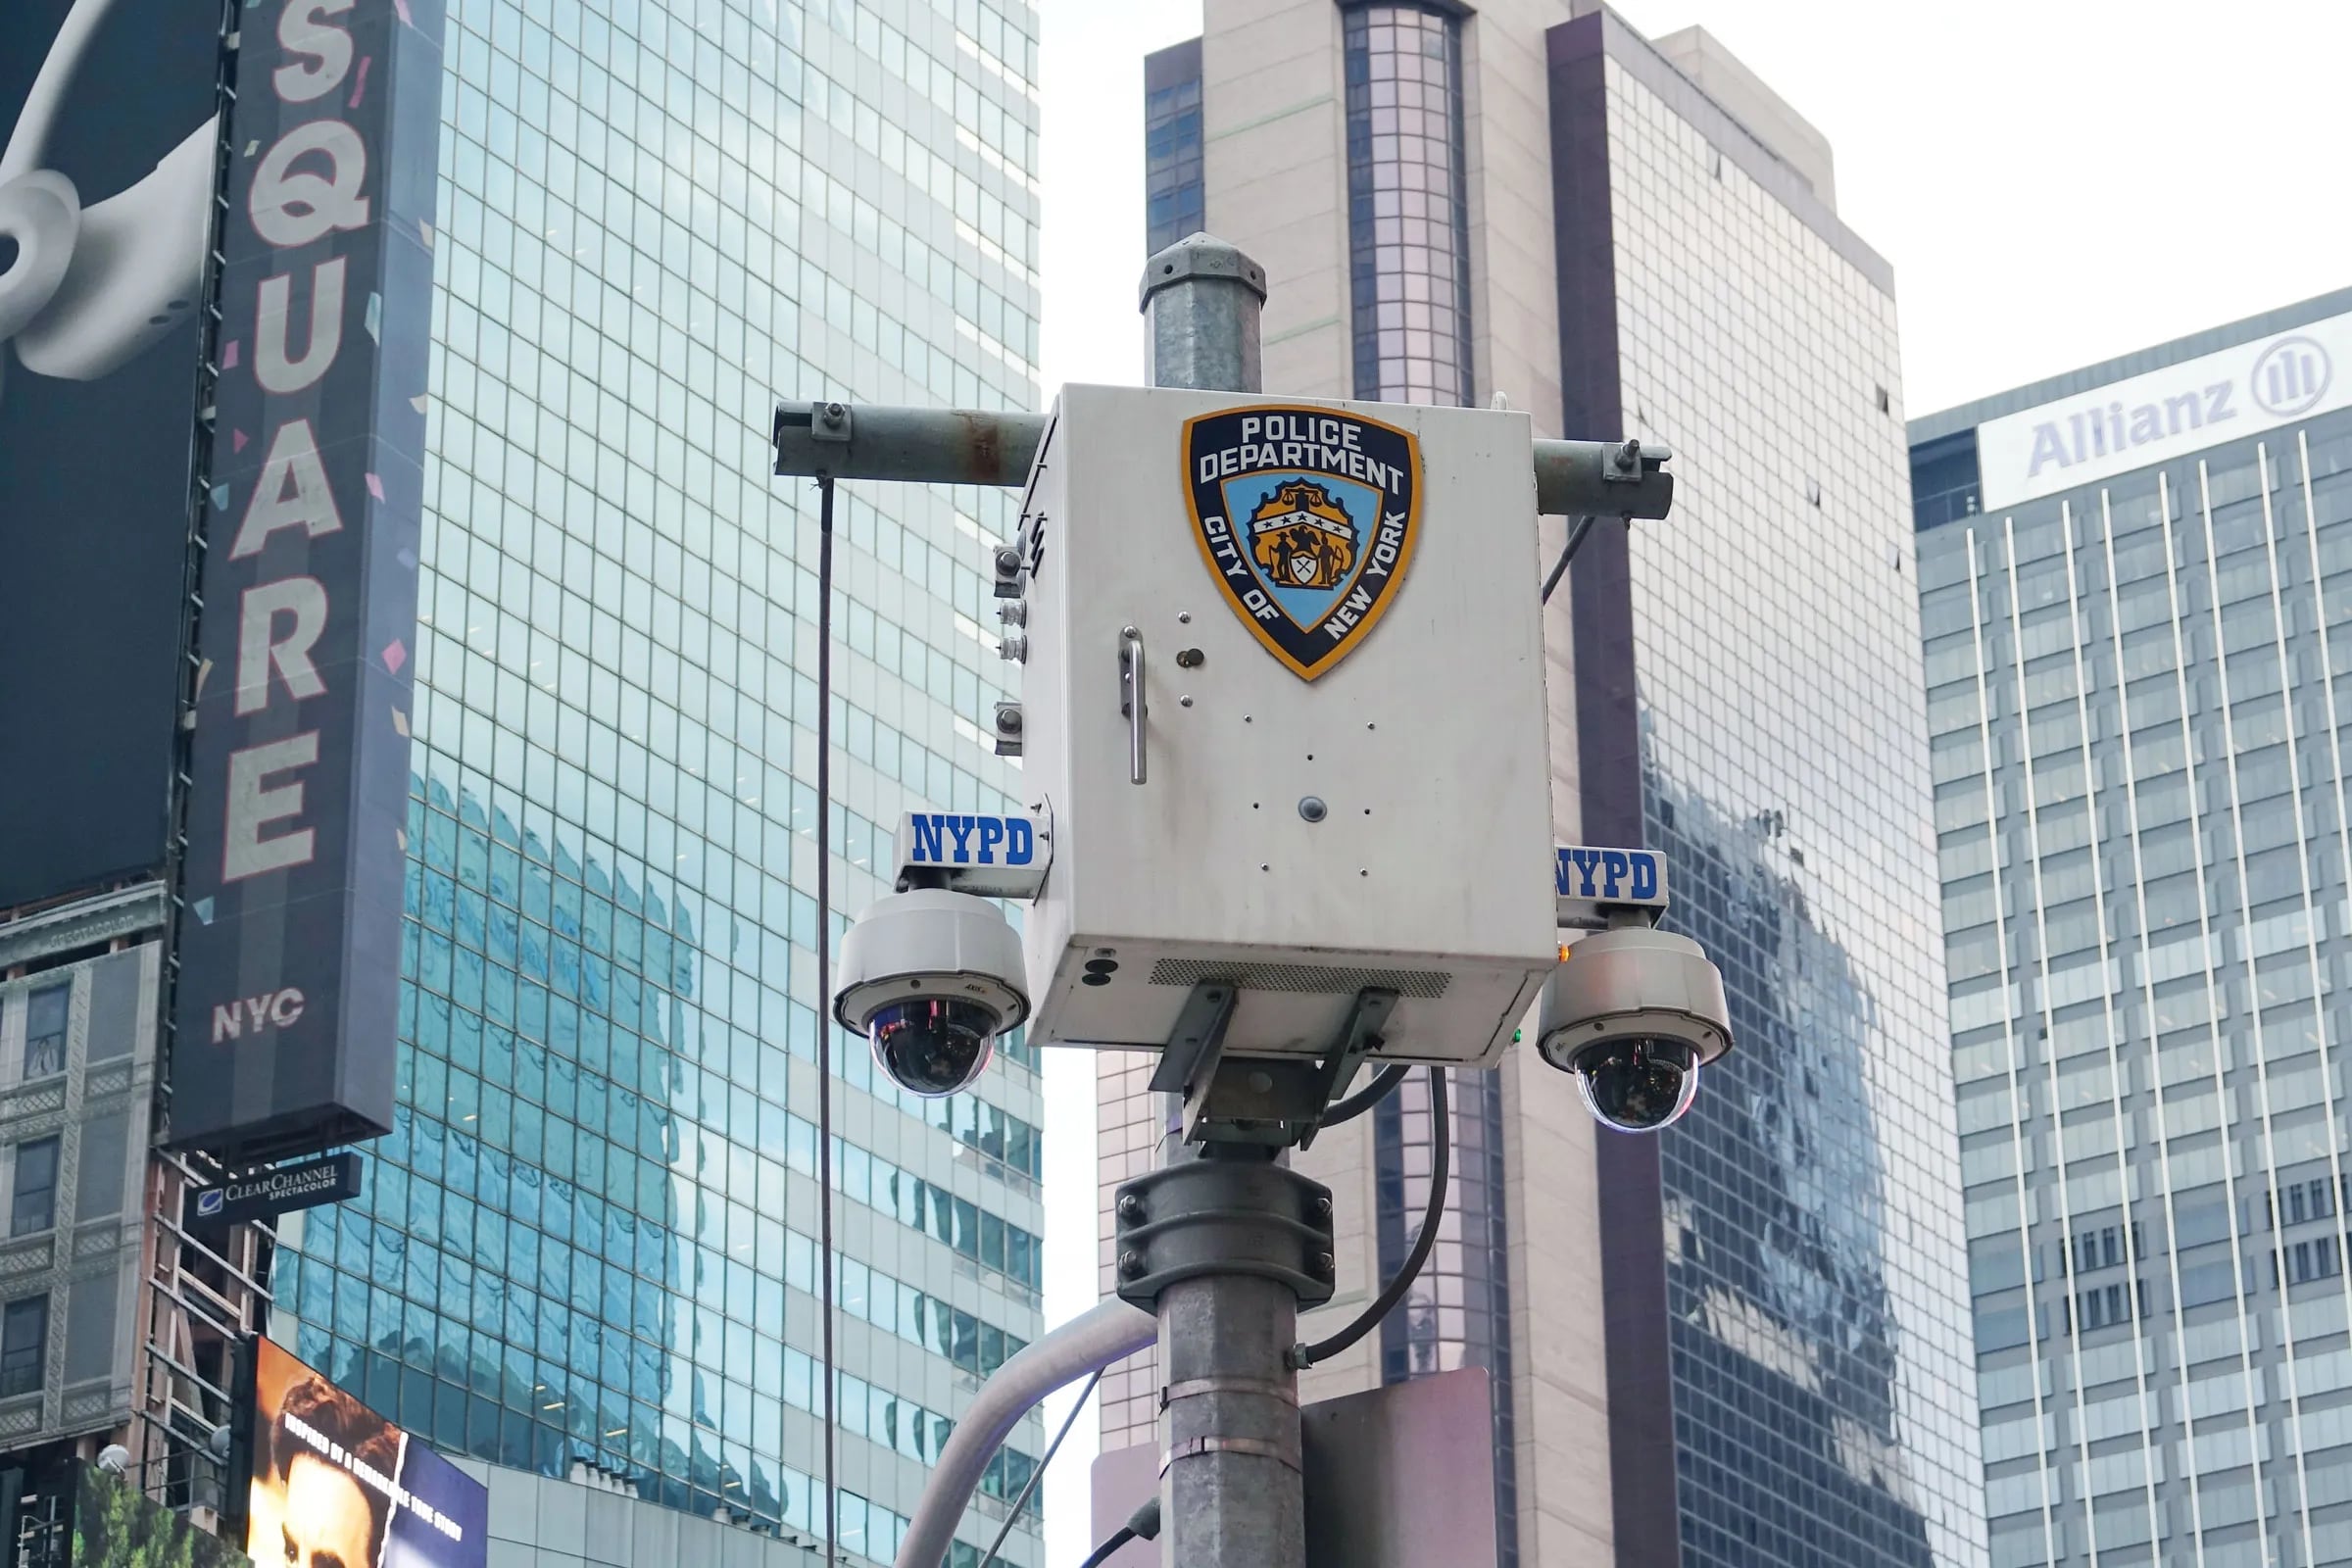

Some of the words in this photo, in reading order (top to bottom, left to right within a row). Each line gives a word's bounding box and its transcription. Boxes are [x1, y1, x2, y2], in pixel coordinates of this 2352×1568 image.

[222, 0, 369, 883] SQUARE
[1241, 415, 1362, 453] POLICE
[2027, 379, 2237, 478] Allianz
[1200, 441, 1404, 495] DEPARTMENT
[1203, 515, 1249, 579] CITY
[1242, 588, 1280, 620] OF
[1323, 584, 1373, 641] NEW
[1365, 510, 1406, 577] YORK
[911, 813, 1034, 865] NYPD
[212, 987, 305, 1045] NYC
[269, 1178, 337, 1200] SPECTACOLOR
